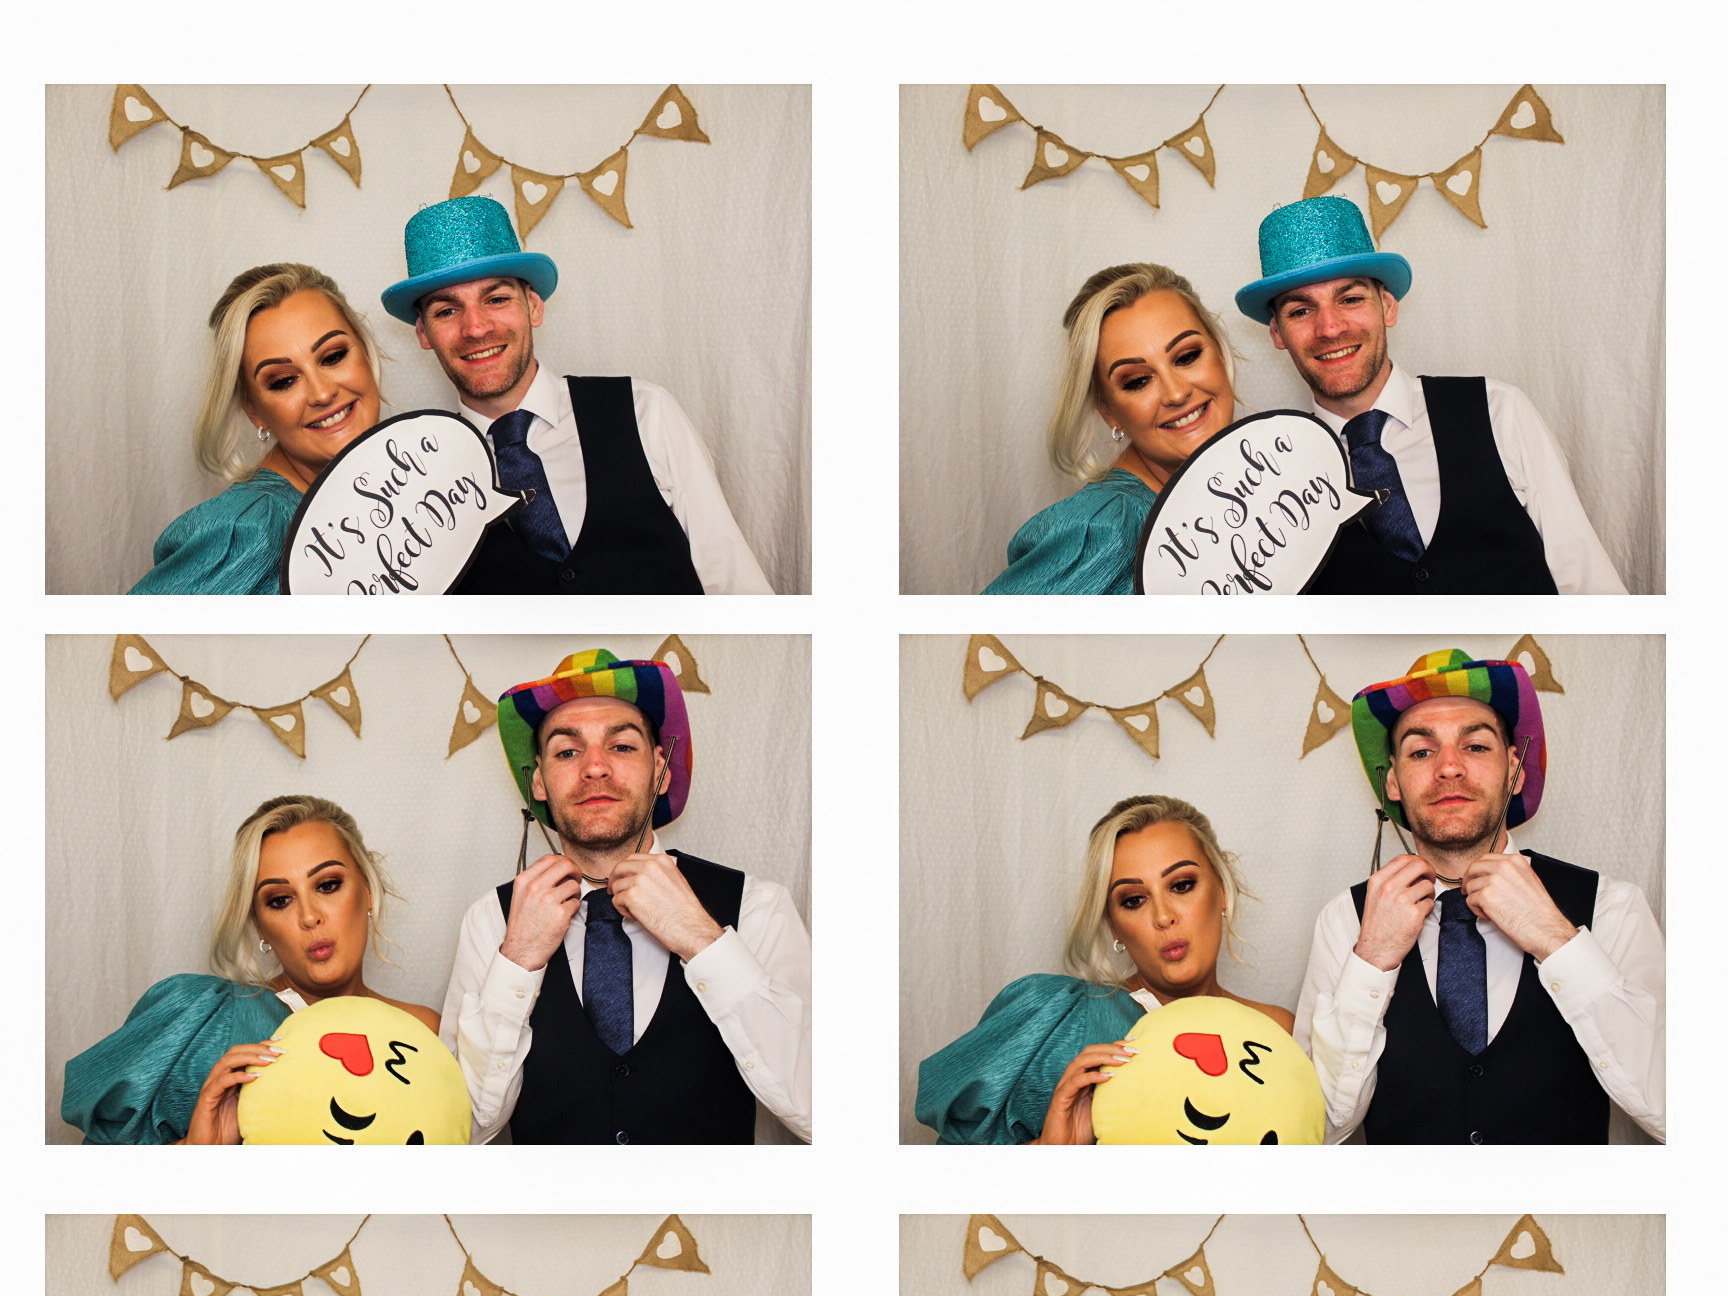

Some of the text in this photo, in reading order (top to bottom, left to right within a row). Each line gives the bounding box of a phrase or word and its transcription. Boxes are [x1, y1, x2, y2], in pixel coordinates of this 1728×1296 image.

[304, 433, 439, 577] It's Such a
[415, 471, 487, 531] Day
[1158, 433, 1293, 577] It's Such a
[1269, 471, 1341, 531] Day
